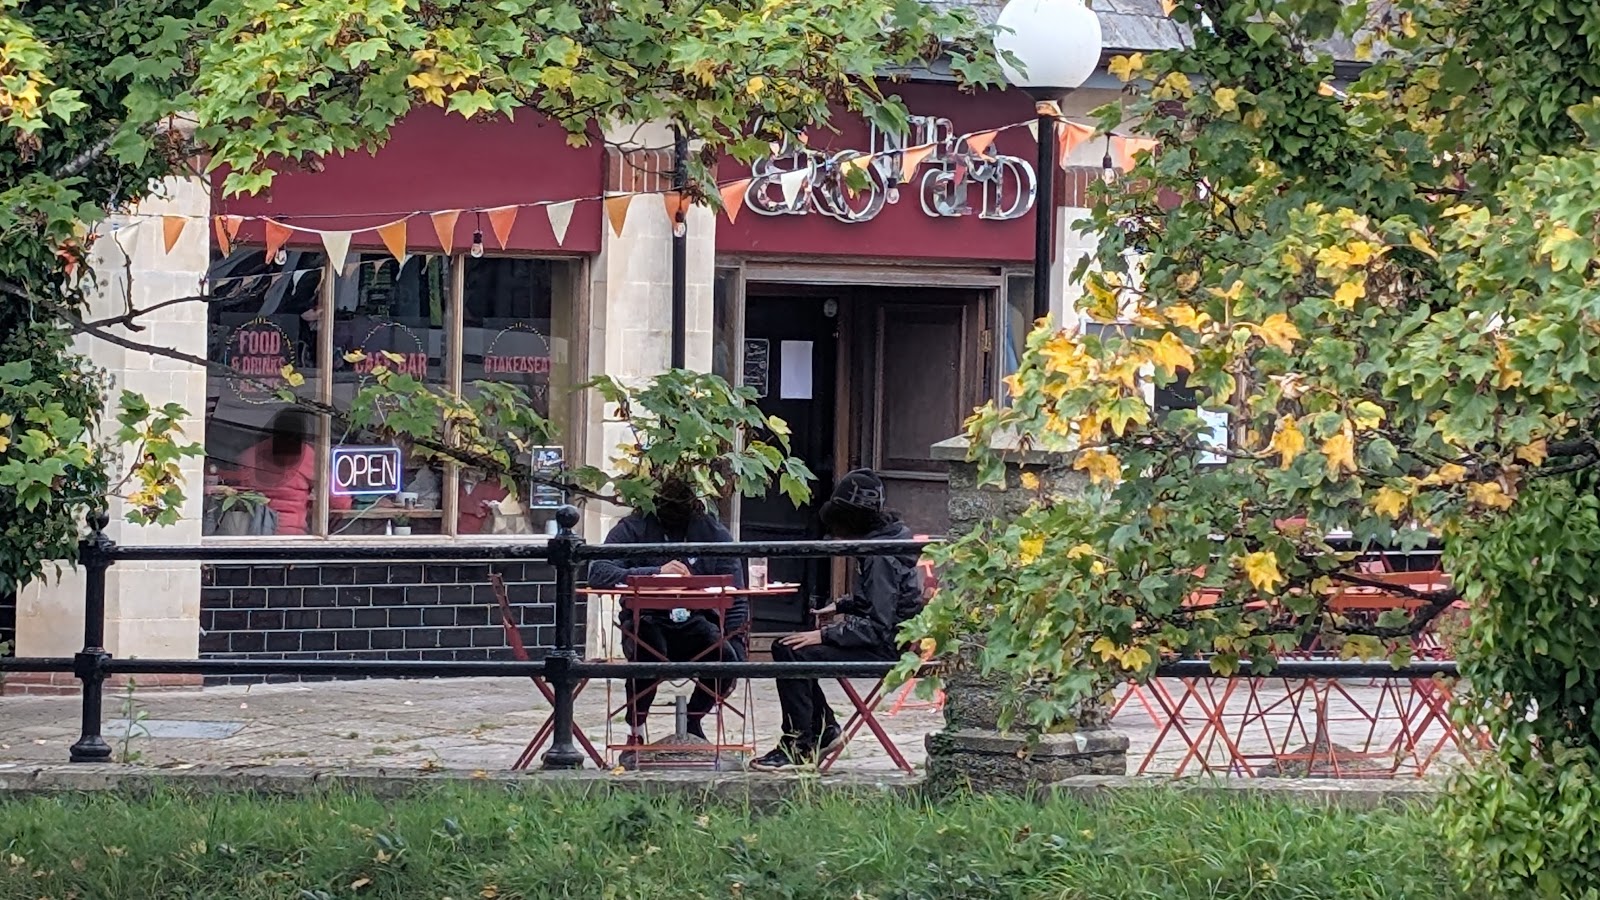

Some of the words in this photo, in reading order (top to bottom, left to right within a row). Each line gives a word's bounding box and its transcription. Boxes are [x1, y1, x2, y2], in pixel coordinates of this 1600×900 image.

[239, 330, 281, 354] FOOD
[231, 356, 240, 371] &
[397, 352, 428, 377] BAR
[335, 453, 397, 487] OPEN
